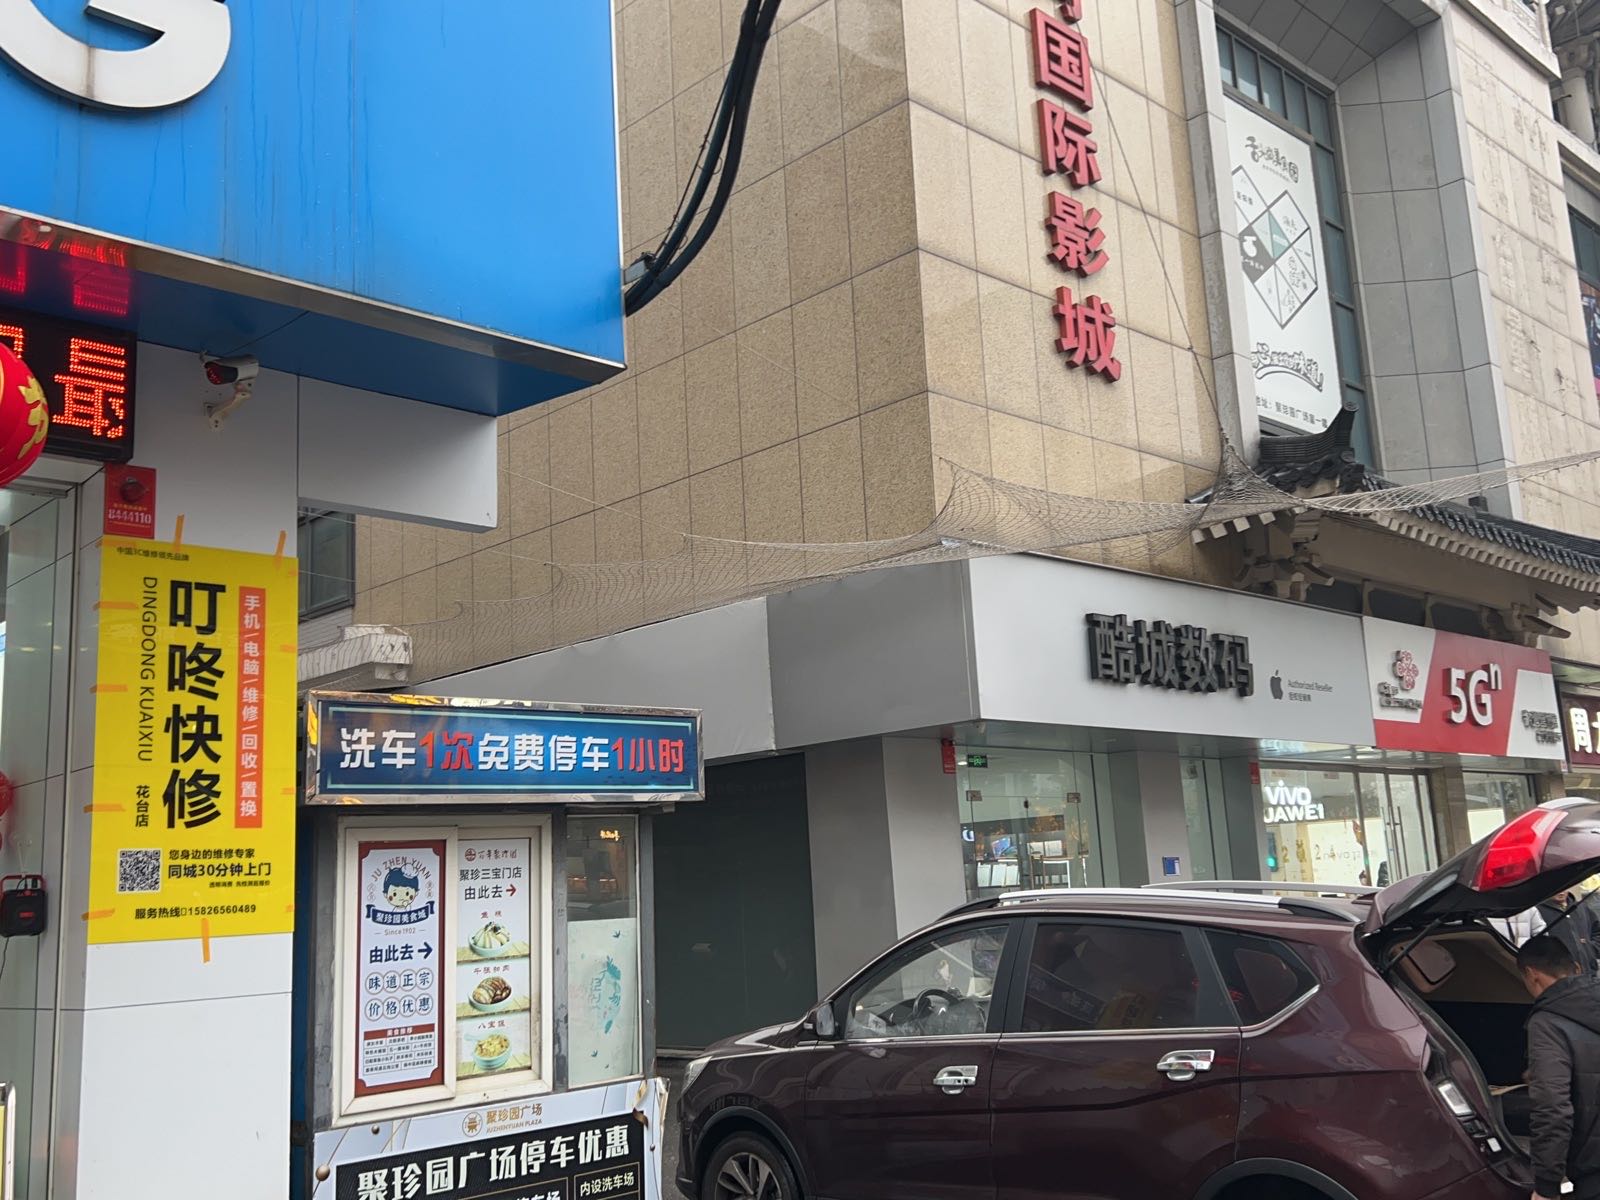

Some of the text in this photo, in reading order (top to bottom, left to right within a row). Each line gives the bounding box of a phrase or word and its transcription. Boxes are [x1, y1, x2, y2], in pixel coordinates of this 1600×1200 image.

[1029, 0, 1121, 382] 国际影城
[108, 509, 152, 524] 8444110
[1086, 613, 1254, 697] 酷城数码
[138, 576, 158, 762] DINGDONG KUAIXIU
[162, 579, 226, 829] 叮咚快修
[340, 727, 684, 773] 洗车1次免费停车1小时
[135, 785, 150, 828] 花台店
[169, 848, 255, 861] 您身边的维修专家
[168, 863, 271, 878] 同城30分钟上门
[459, 867, 522, 881] 聚珍三宝门店
[464, 884, 503, 900] 由此去
[369, 943, 414, 964] 由此去
[368, 971, 430, 991] 味道正宗
[368, 997, 430, 1018] 价格优惠
[486, 1104, 543, 1124] 聚珍园广场
[357, 1124, 630, 1200] 聚珍园广场停车优惠
[580, 1172, 635, 1197] 内设洗车场
